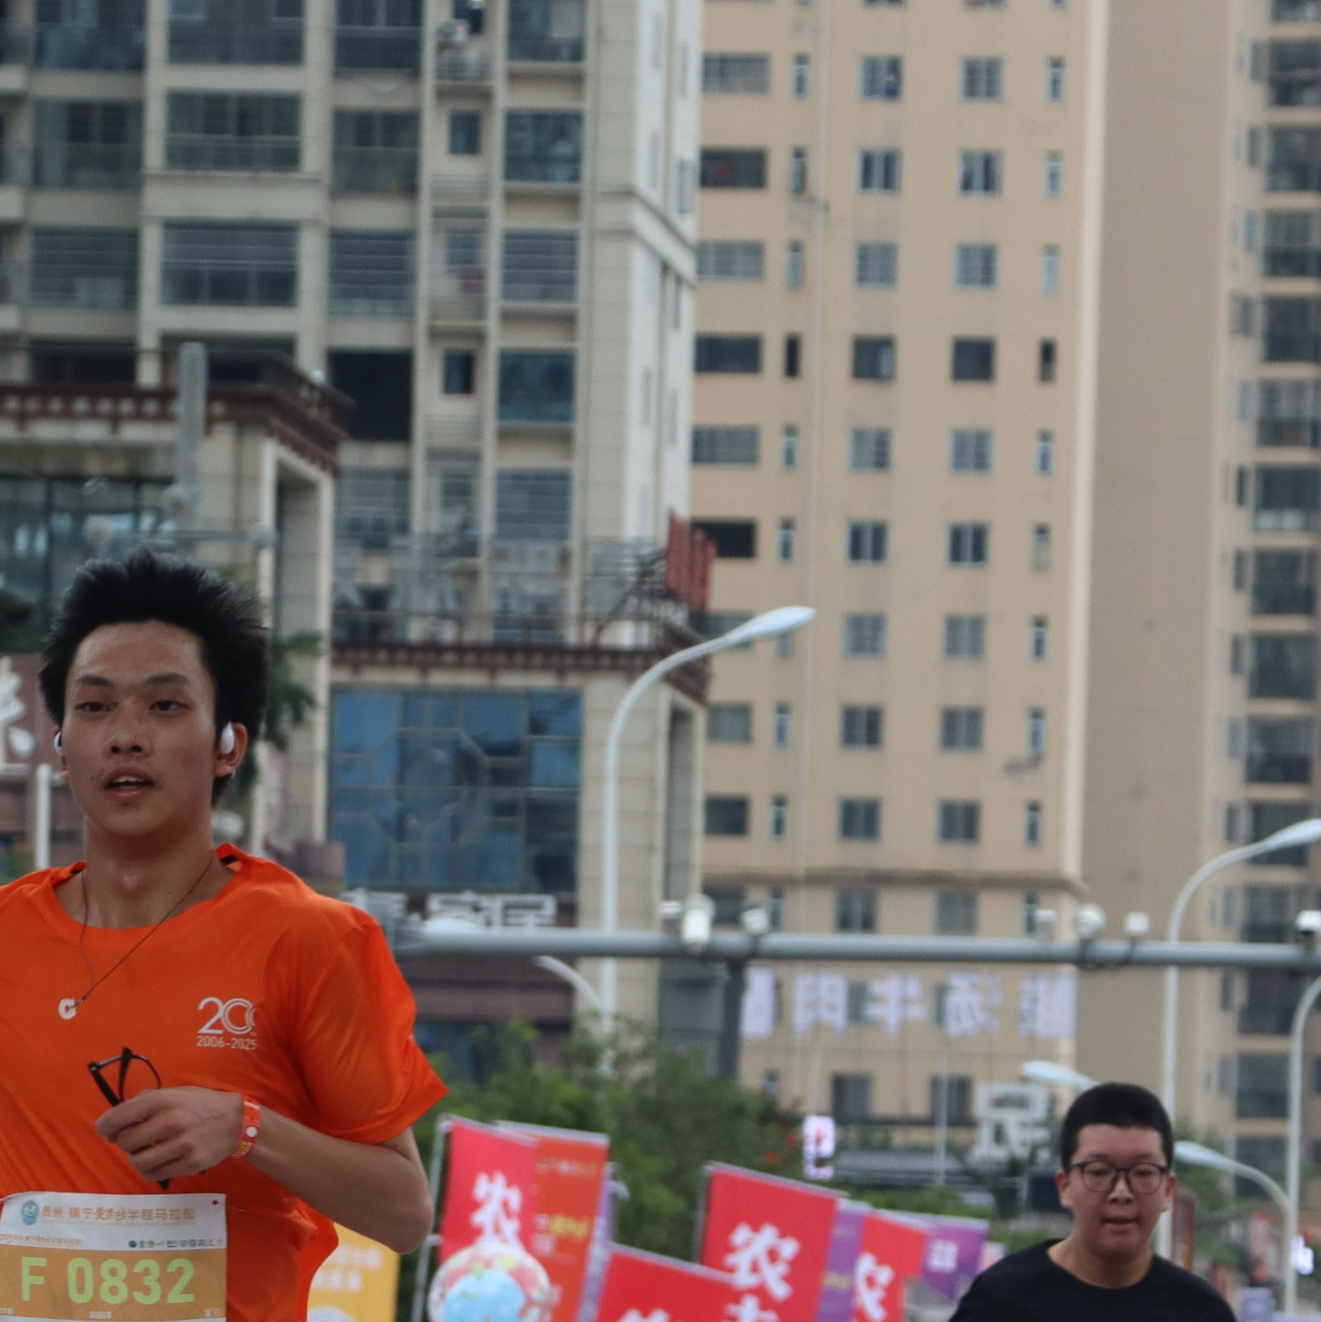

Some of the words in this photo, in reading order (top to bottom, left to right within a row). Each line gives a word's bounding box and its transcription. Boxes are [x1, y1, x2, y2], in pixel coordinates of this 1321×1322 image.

[196, 1035, 257, 1051] 2006-2025
[21, 1256, 48, 1301] F
[67, 1257, 195, 1305] 0832
